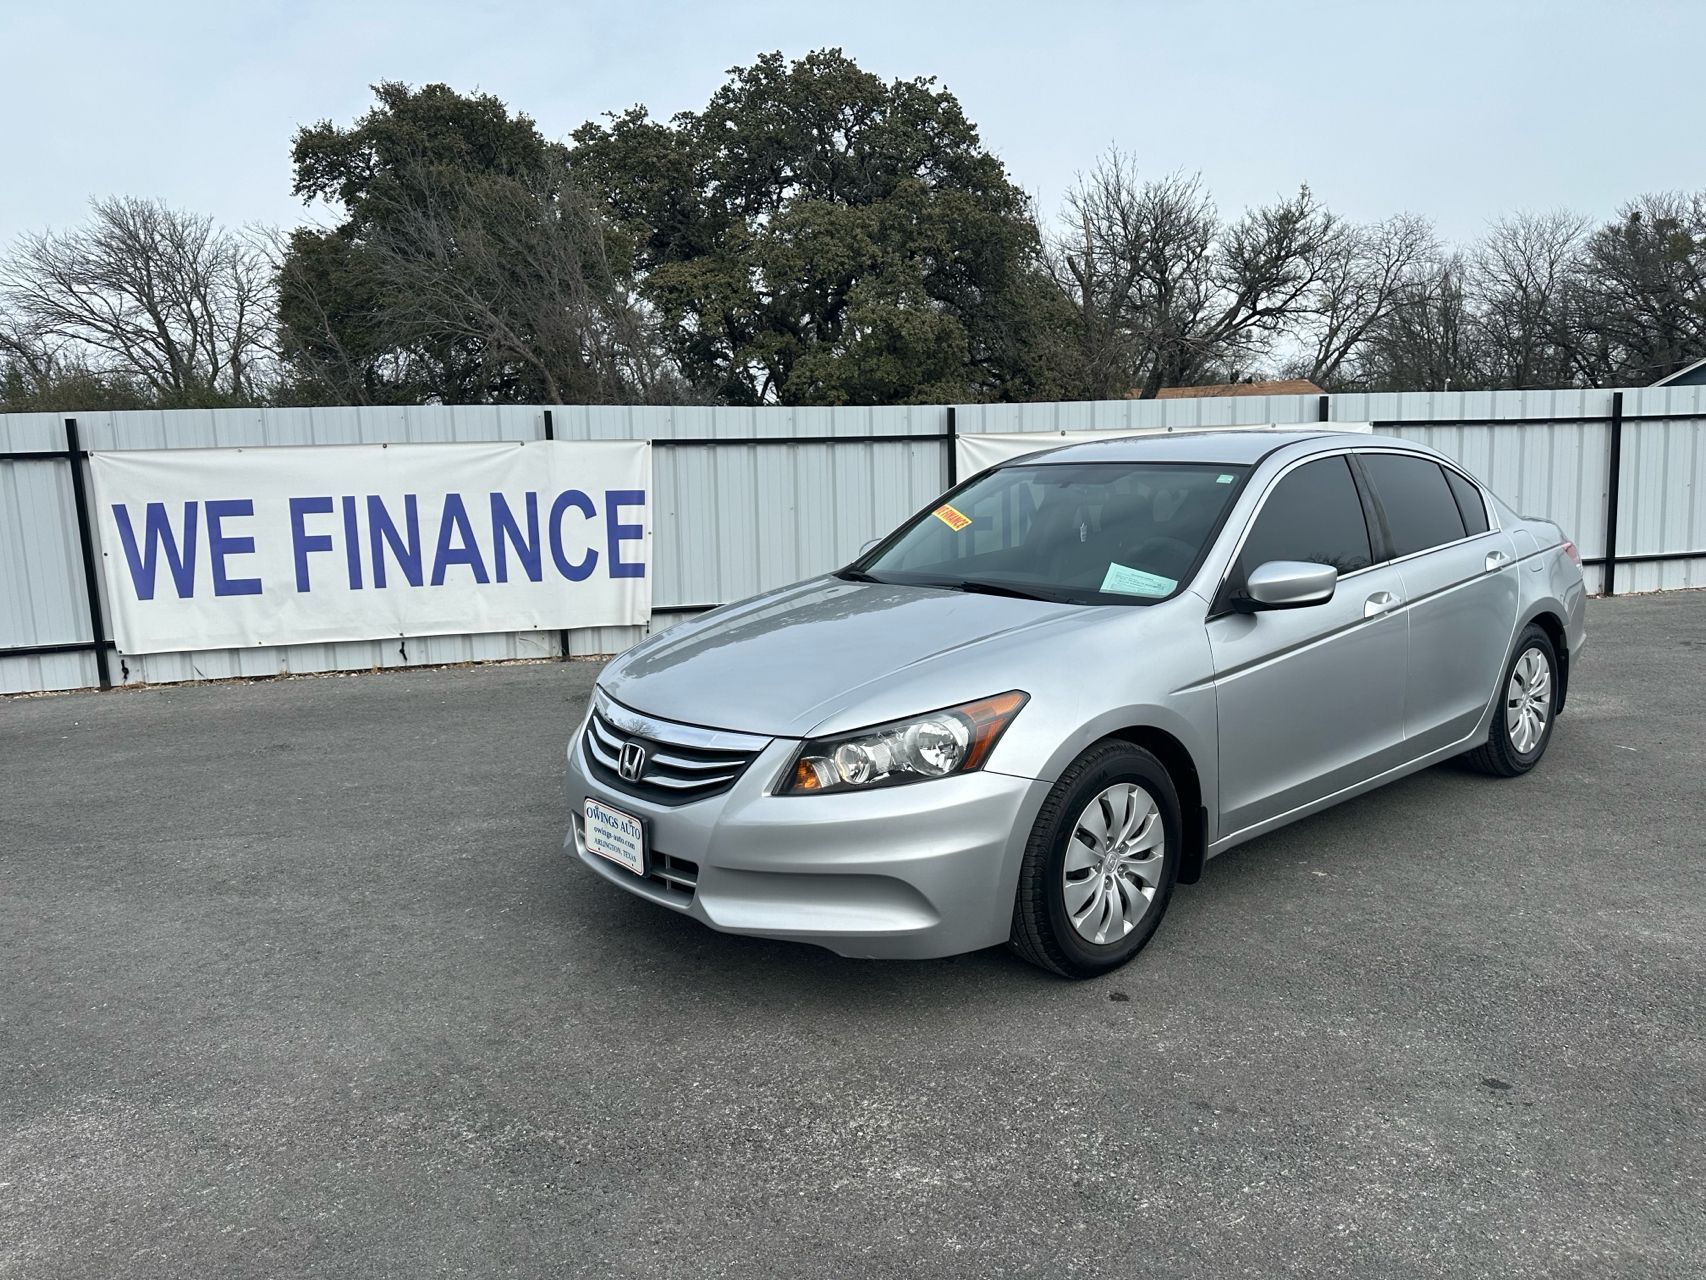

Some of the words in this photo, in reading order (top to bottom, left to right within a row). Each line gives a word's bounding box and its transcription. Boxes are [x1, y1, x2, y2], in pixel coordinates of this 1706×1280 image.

[111, 499, 263, 600] WE
[289, 489, 646, 593] FINANCE
[586, 806, 619, 829] OWINGS
[620, 821, 641, 840] AUTO
